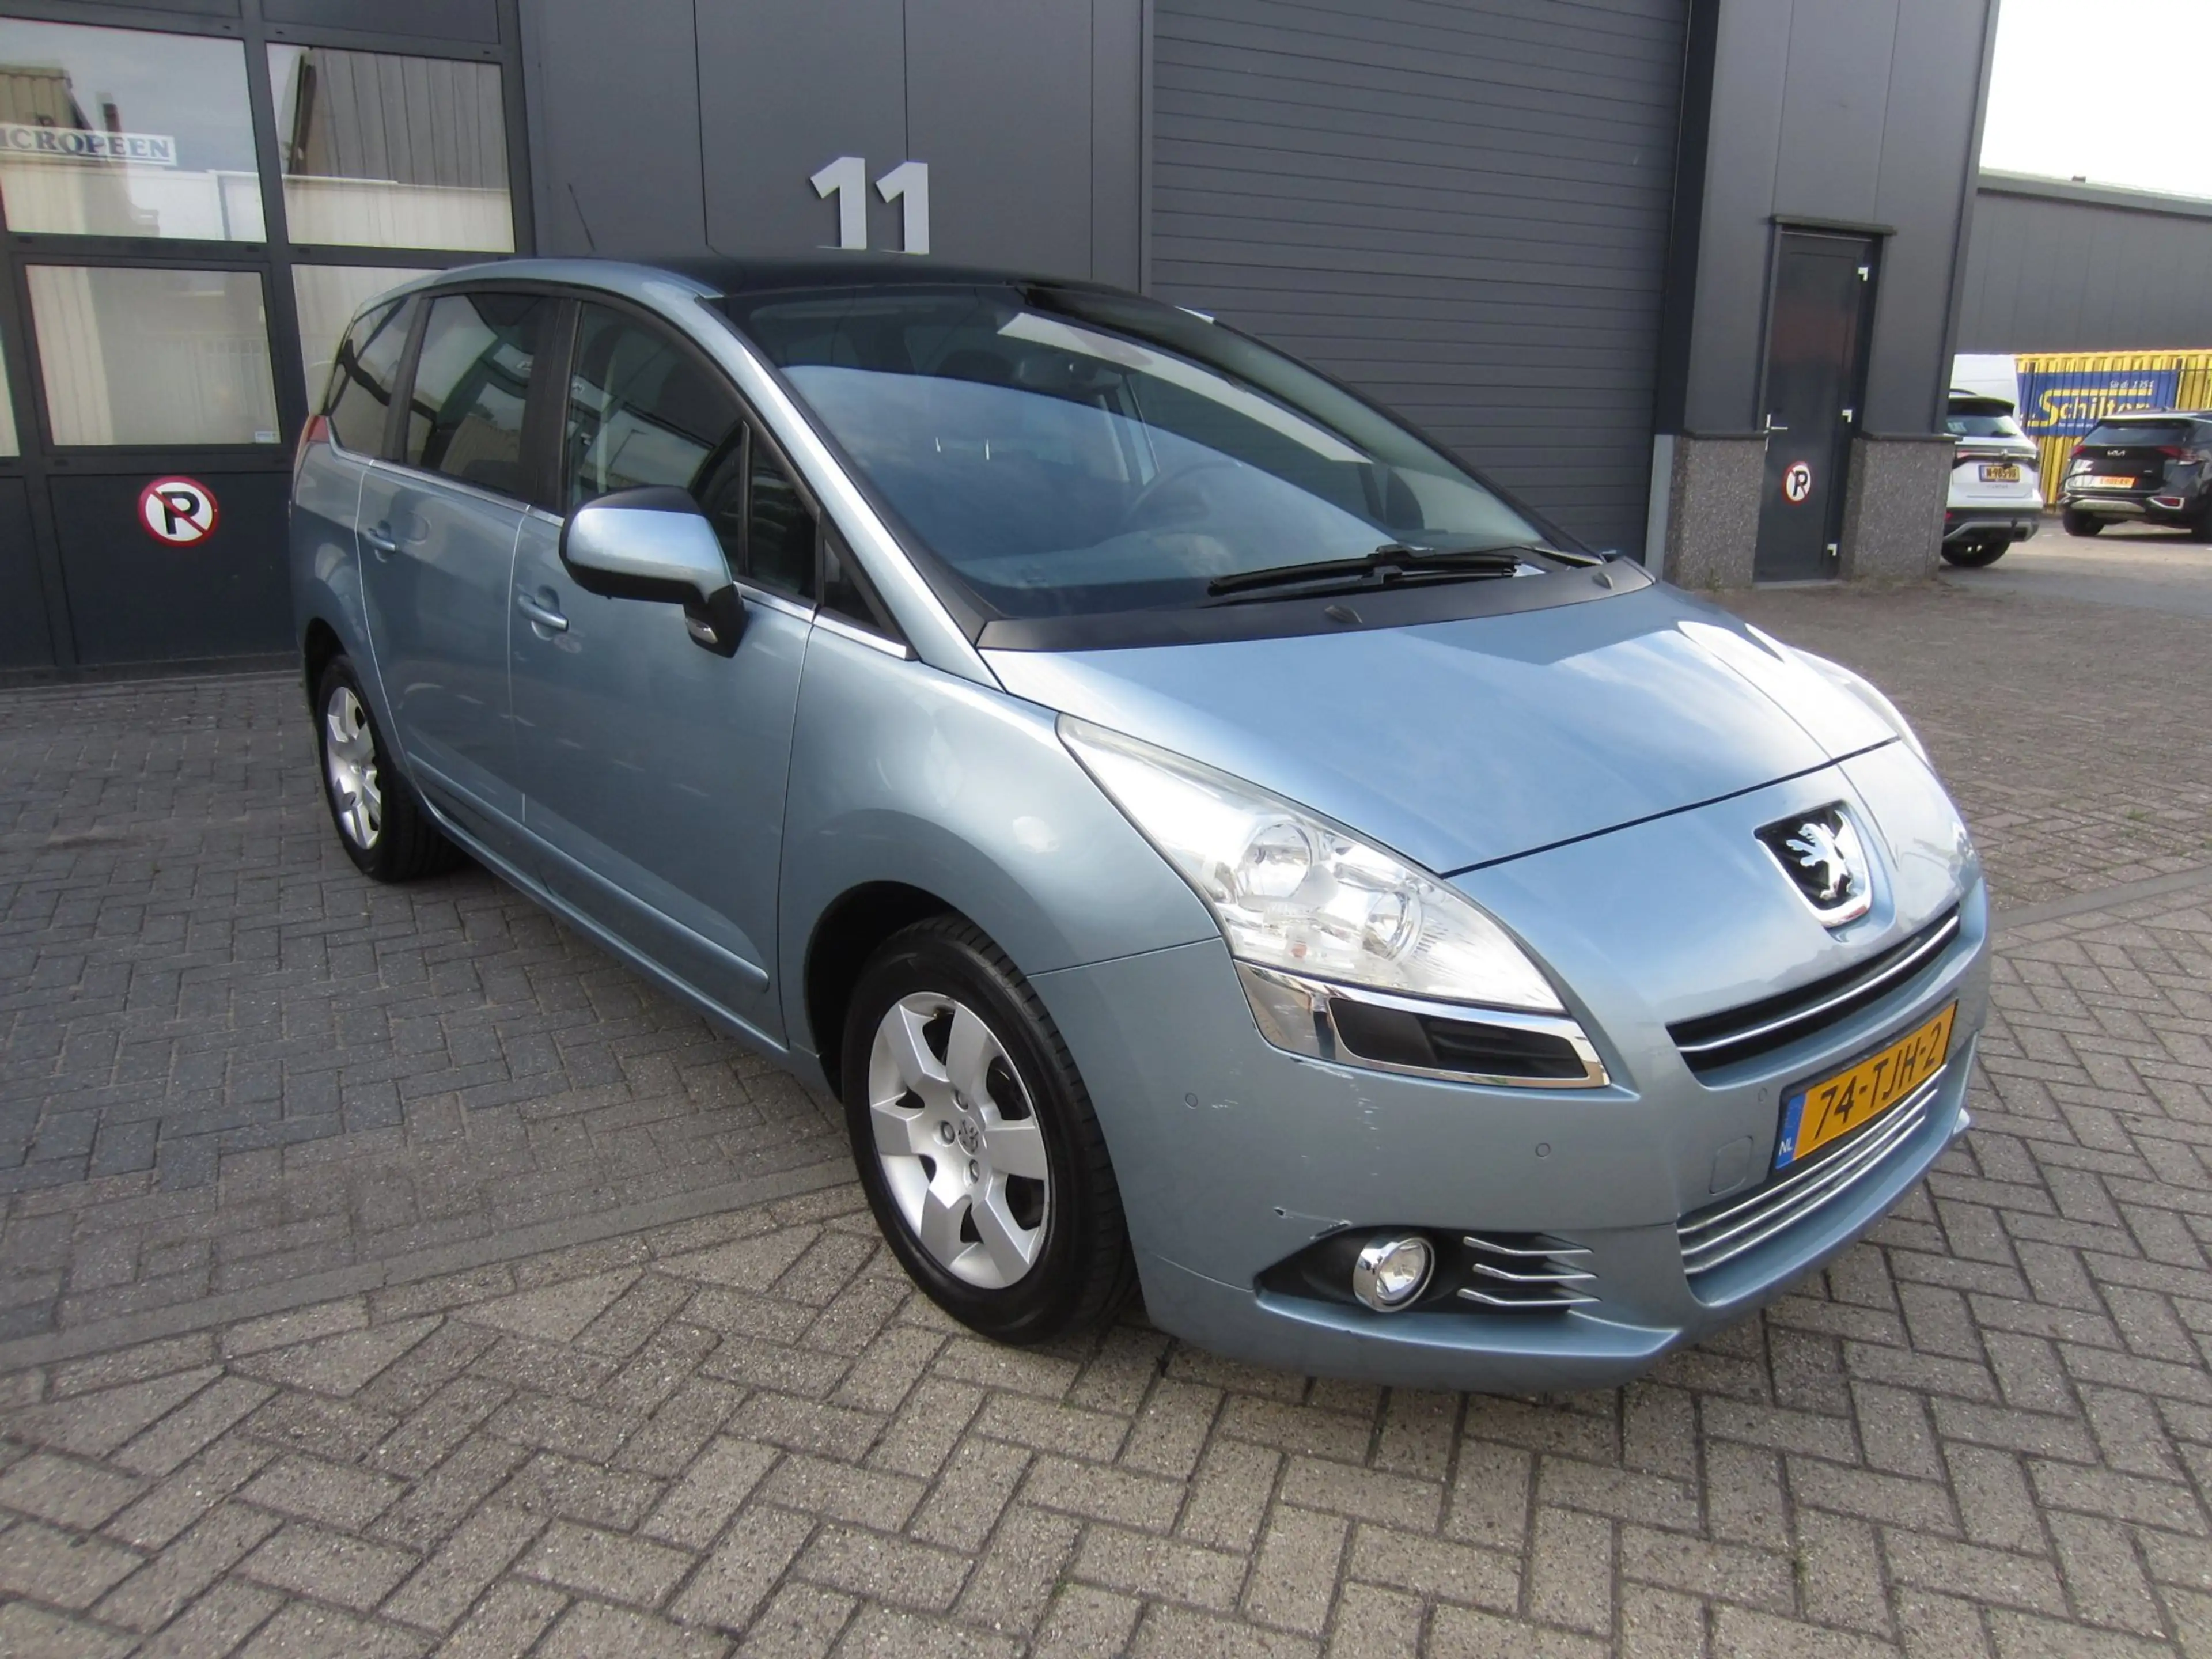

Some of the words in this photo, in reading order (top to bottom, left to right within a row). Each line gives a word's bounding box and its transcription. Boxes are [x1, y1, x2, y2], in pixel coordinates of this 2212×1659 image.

[809, 156, 929, 255] 11
[1814, 1021, 1942, 1141] 74-TJH-2
[1778, 1138, 1793, 1156] NL
